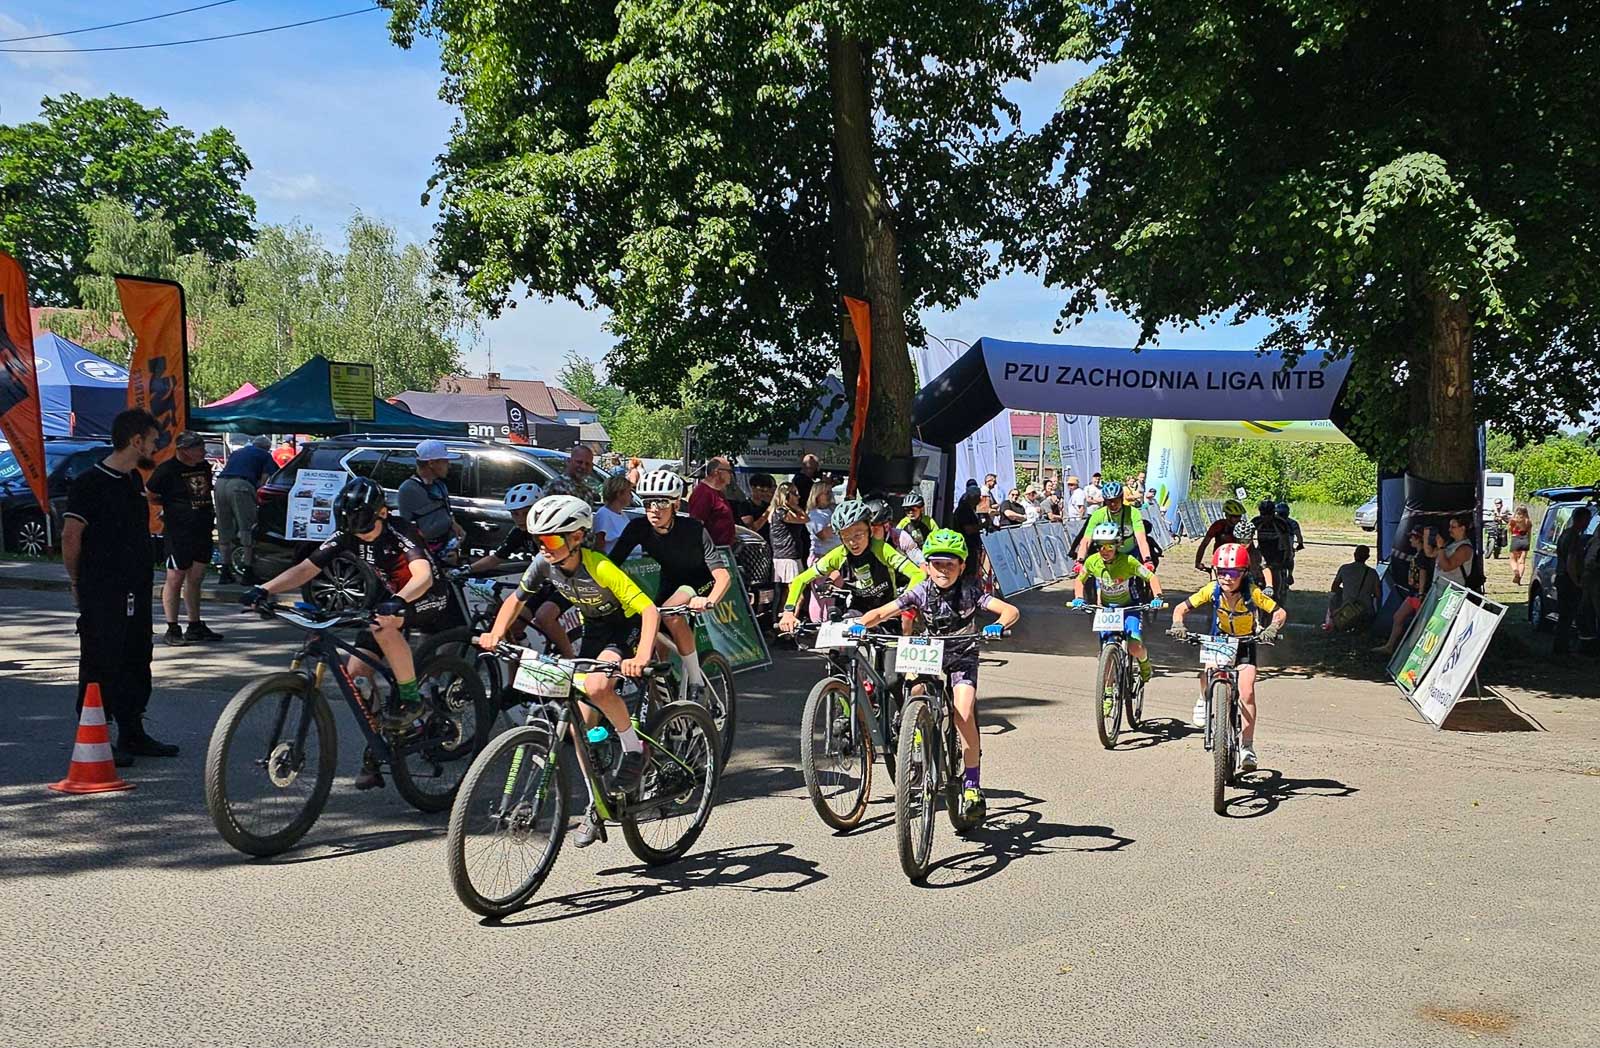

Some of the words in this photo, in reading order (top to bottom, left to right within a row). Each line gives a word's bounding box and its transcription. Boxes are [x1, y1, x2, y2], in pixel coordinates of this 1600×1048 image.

[1003, 362, 1050, 383] PZU
[1056, 366, 1199, 390] ZACHODNIA
[1207, 371, 1265, 391] LIGA
[1272, 370, 1326, 391] MTB
[1097, 614, 1121, 624] 1002
[900, 647, 939, 663] 4012
